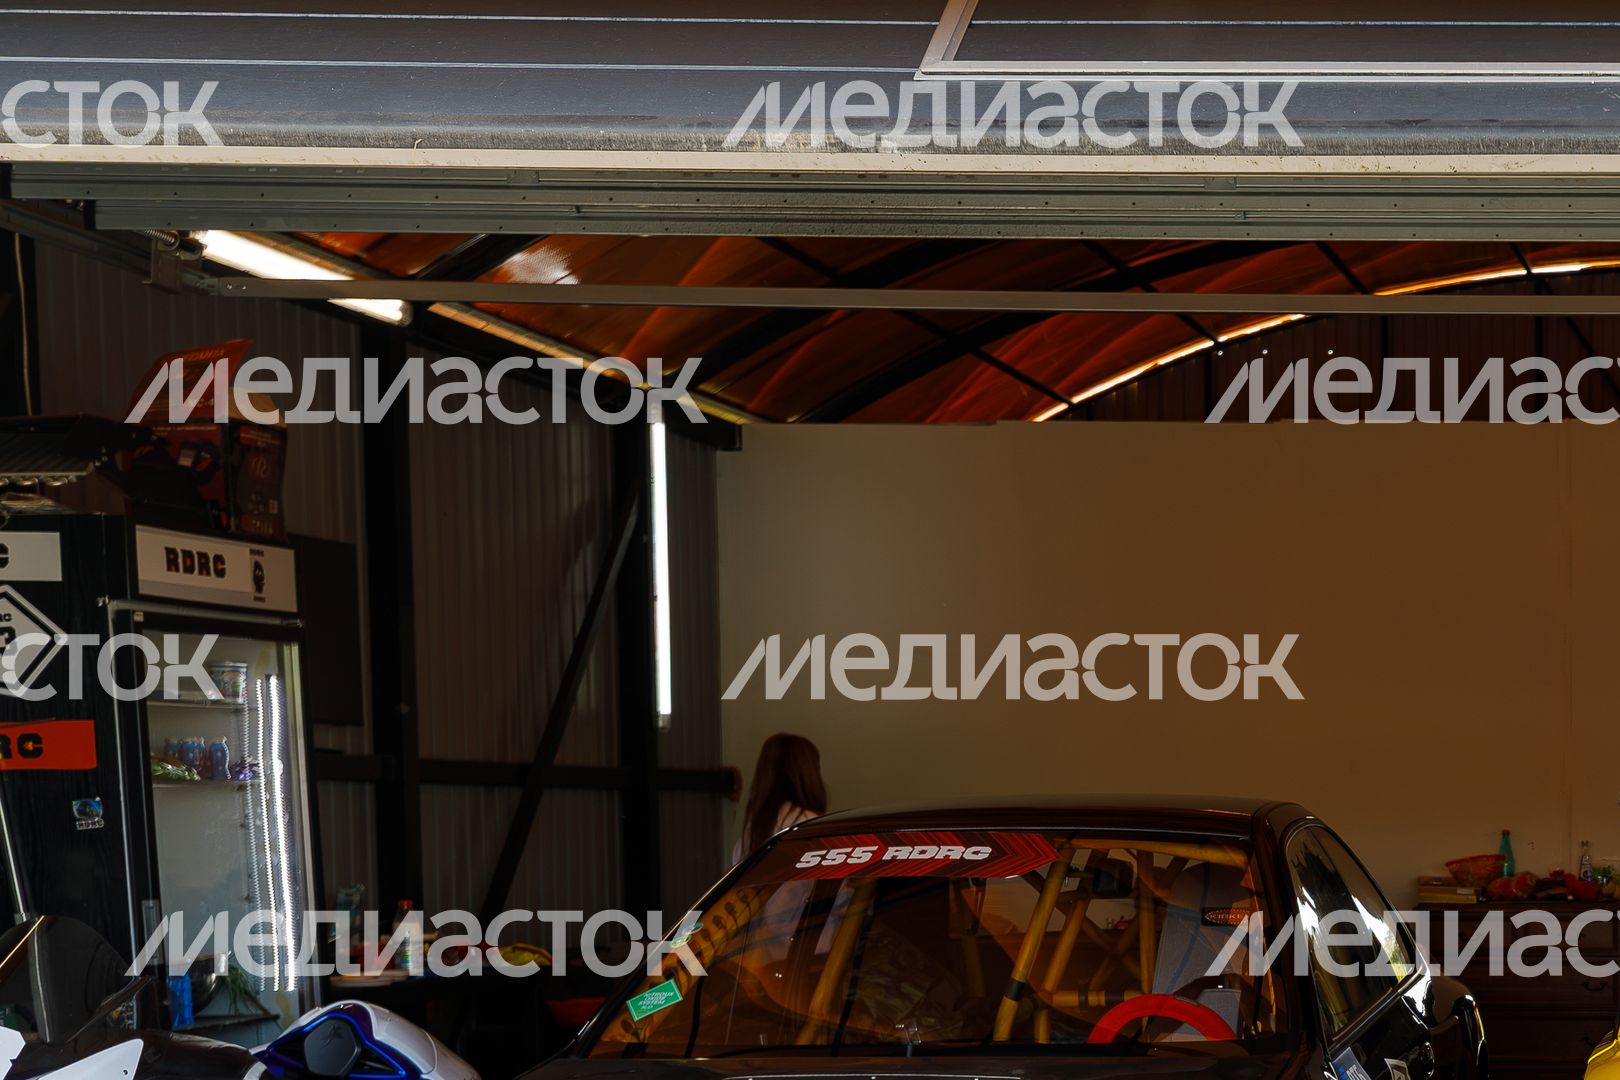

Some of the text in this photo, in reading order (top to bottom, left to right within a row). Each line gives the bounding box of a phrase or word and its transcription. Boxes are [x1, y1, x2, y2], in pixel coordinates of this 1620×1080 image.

[164, 547, 226, 578] RDRC
[795, 845, 992, 868] 555 RDRC
